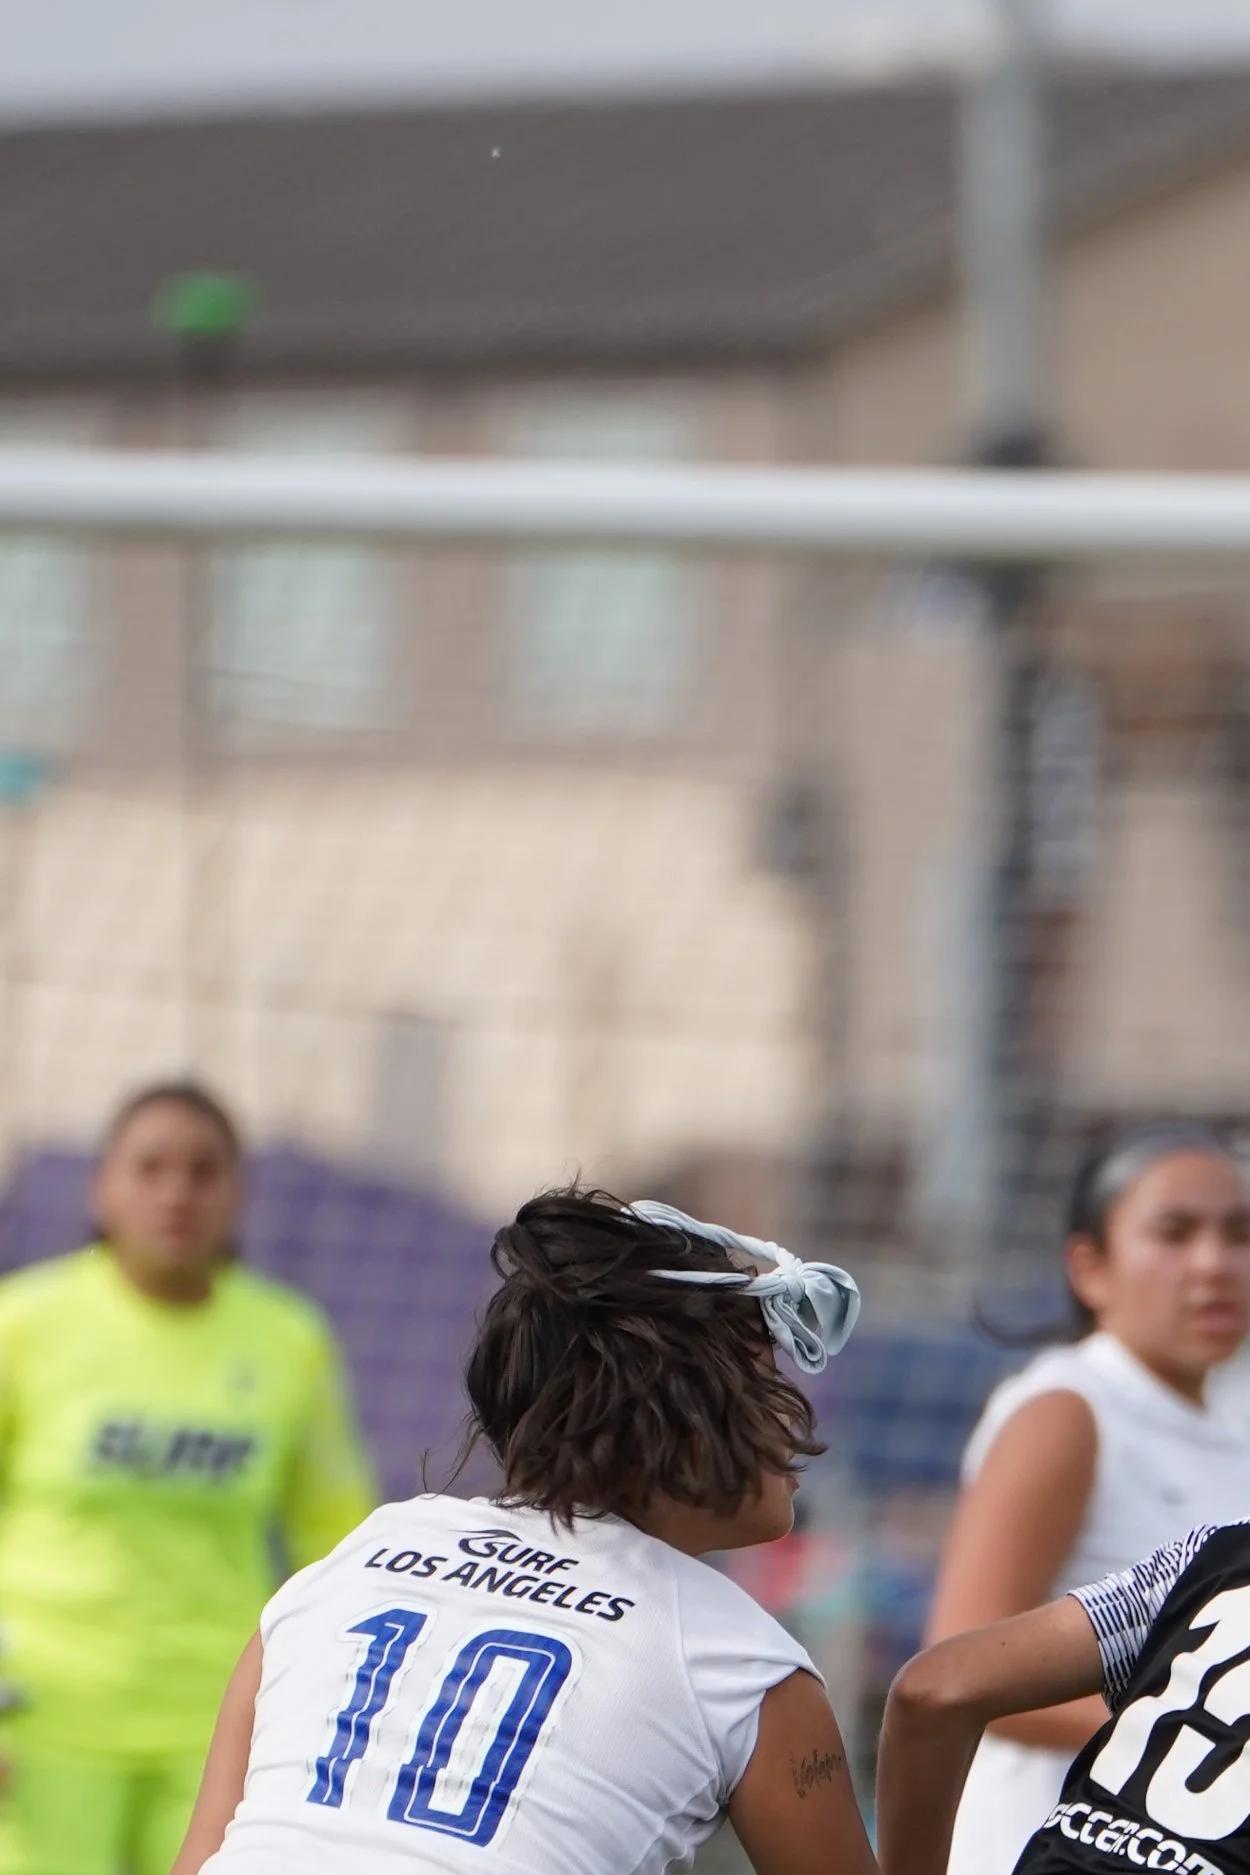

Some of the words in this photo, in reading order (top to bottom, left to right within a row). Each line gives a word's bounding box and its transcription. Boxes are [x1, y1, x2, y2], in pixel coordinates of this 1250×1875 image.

[364, 1548, 448, 1578] LOS
[440, 1561, 636, 1622] ANGELES
[453, 1528, 579, 1575] SURF
[305, 1607, 574, 1848] 10
